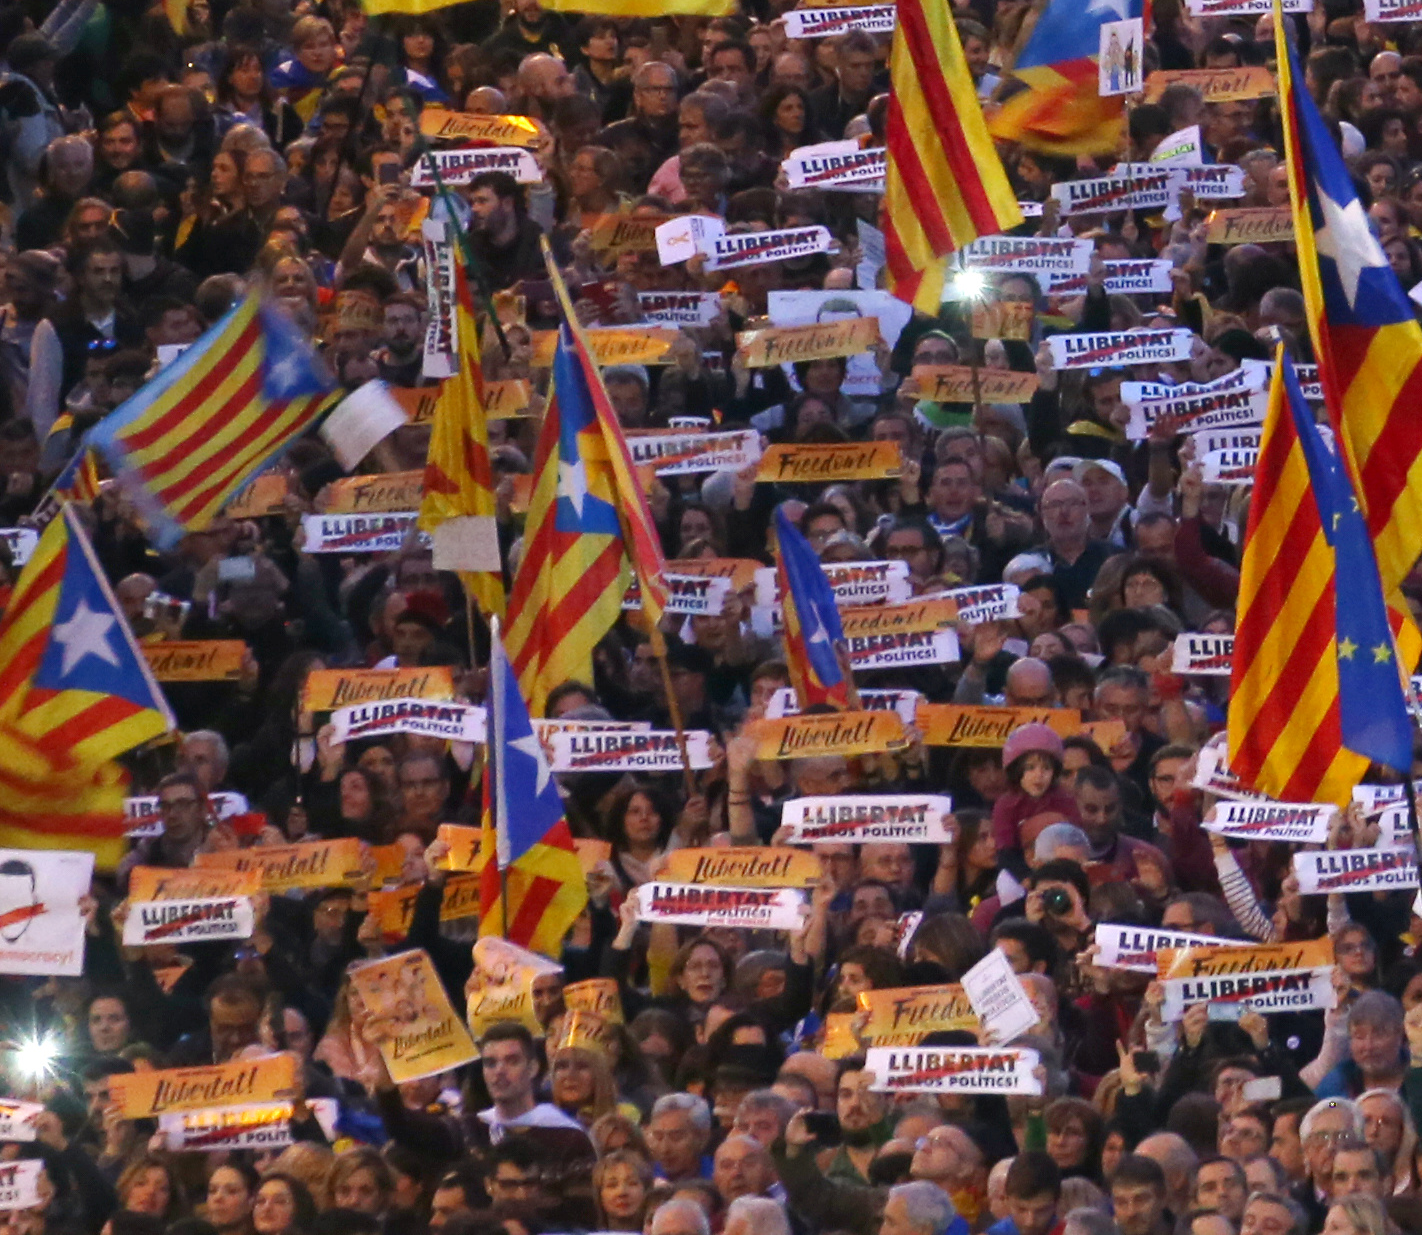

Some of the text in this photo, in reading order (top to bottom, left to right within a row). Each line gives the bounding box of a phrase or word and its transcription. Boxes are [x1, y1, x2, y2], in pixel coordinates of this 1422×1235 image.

[1066, 331, 1176, 352] LLIBERTAT
[349, 704, 466, 725] LLIBERTAT
[802, 804, 929, 824] LLIBERTAT
[1182, 973, 1313, 1000] LLIBERTAT
[889, 1053, 1017, 1073] LLIBERTAT
